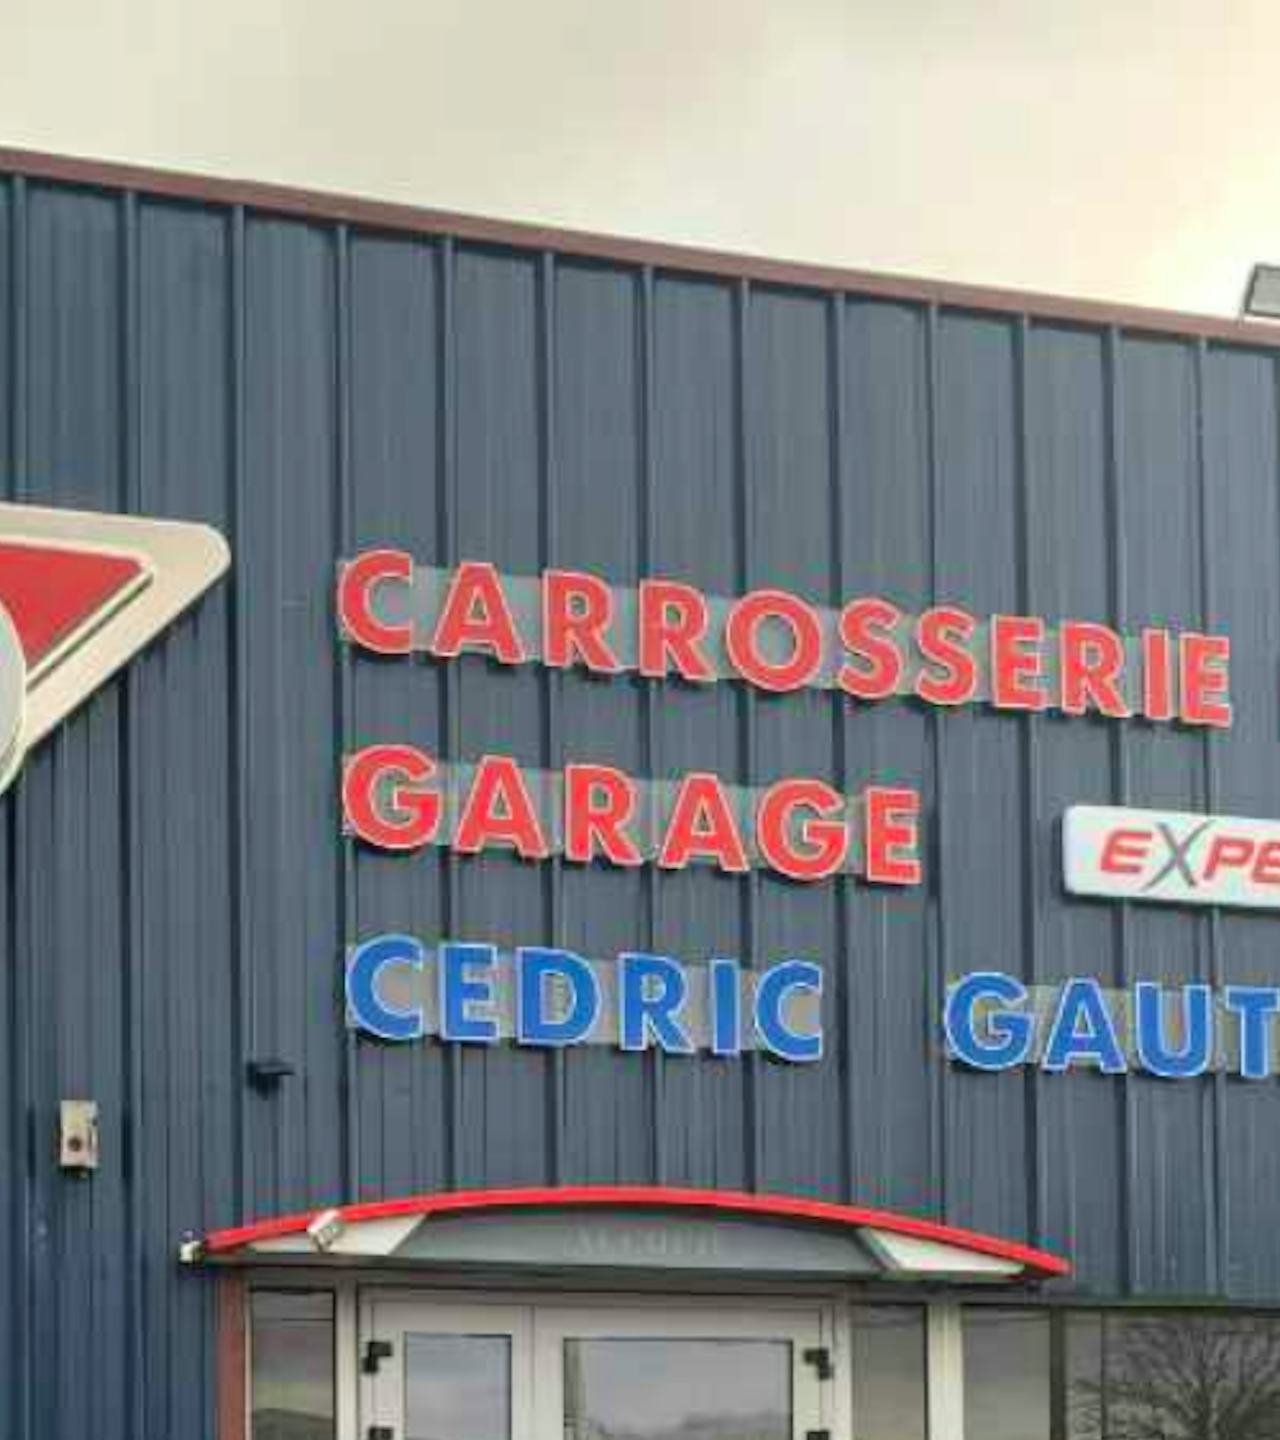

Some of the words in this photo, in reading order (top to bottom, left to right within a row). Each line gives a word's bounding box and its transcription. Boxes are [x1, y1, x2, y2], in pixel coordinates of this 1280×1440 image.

[337, 548, 1234, 730] CARROSSERIE
[339, 743, 923, 887] GARAGE
[343, 934, 826, 1065] CEDRIC
